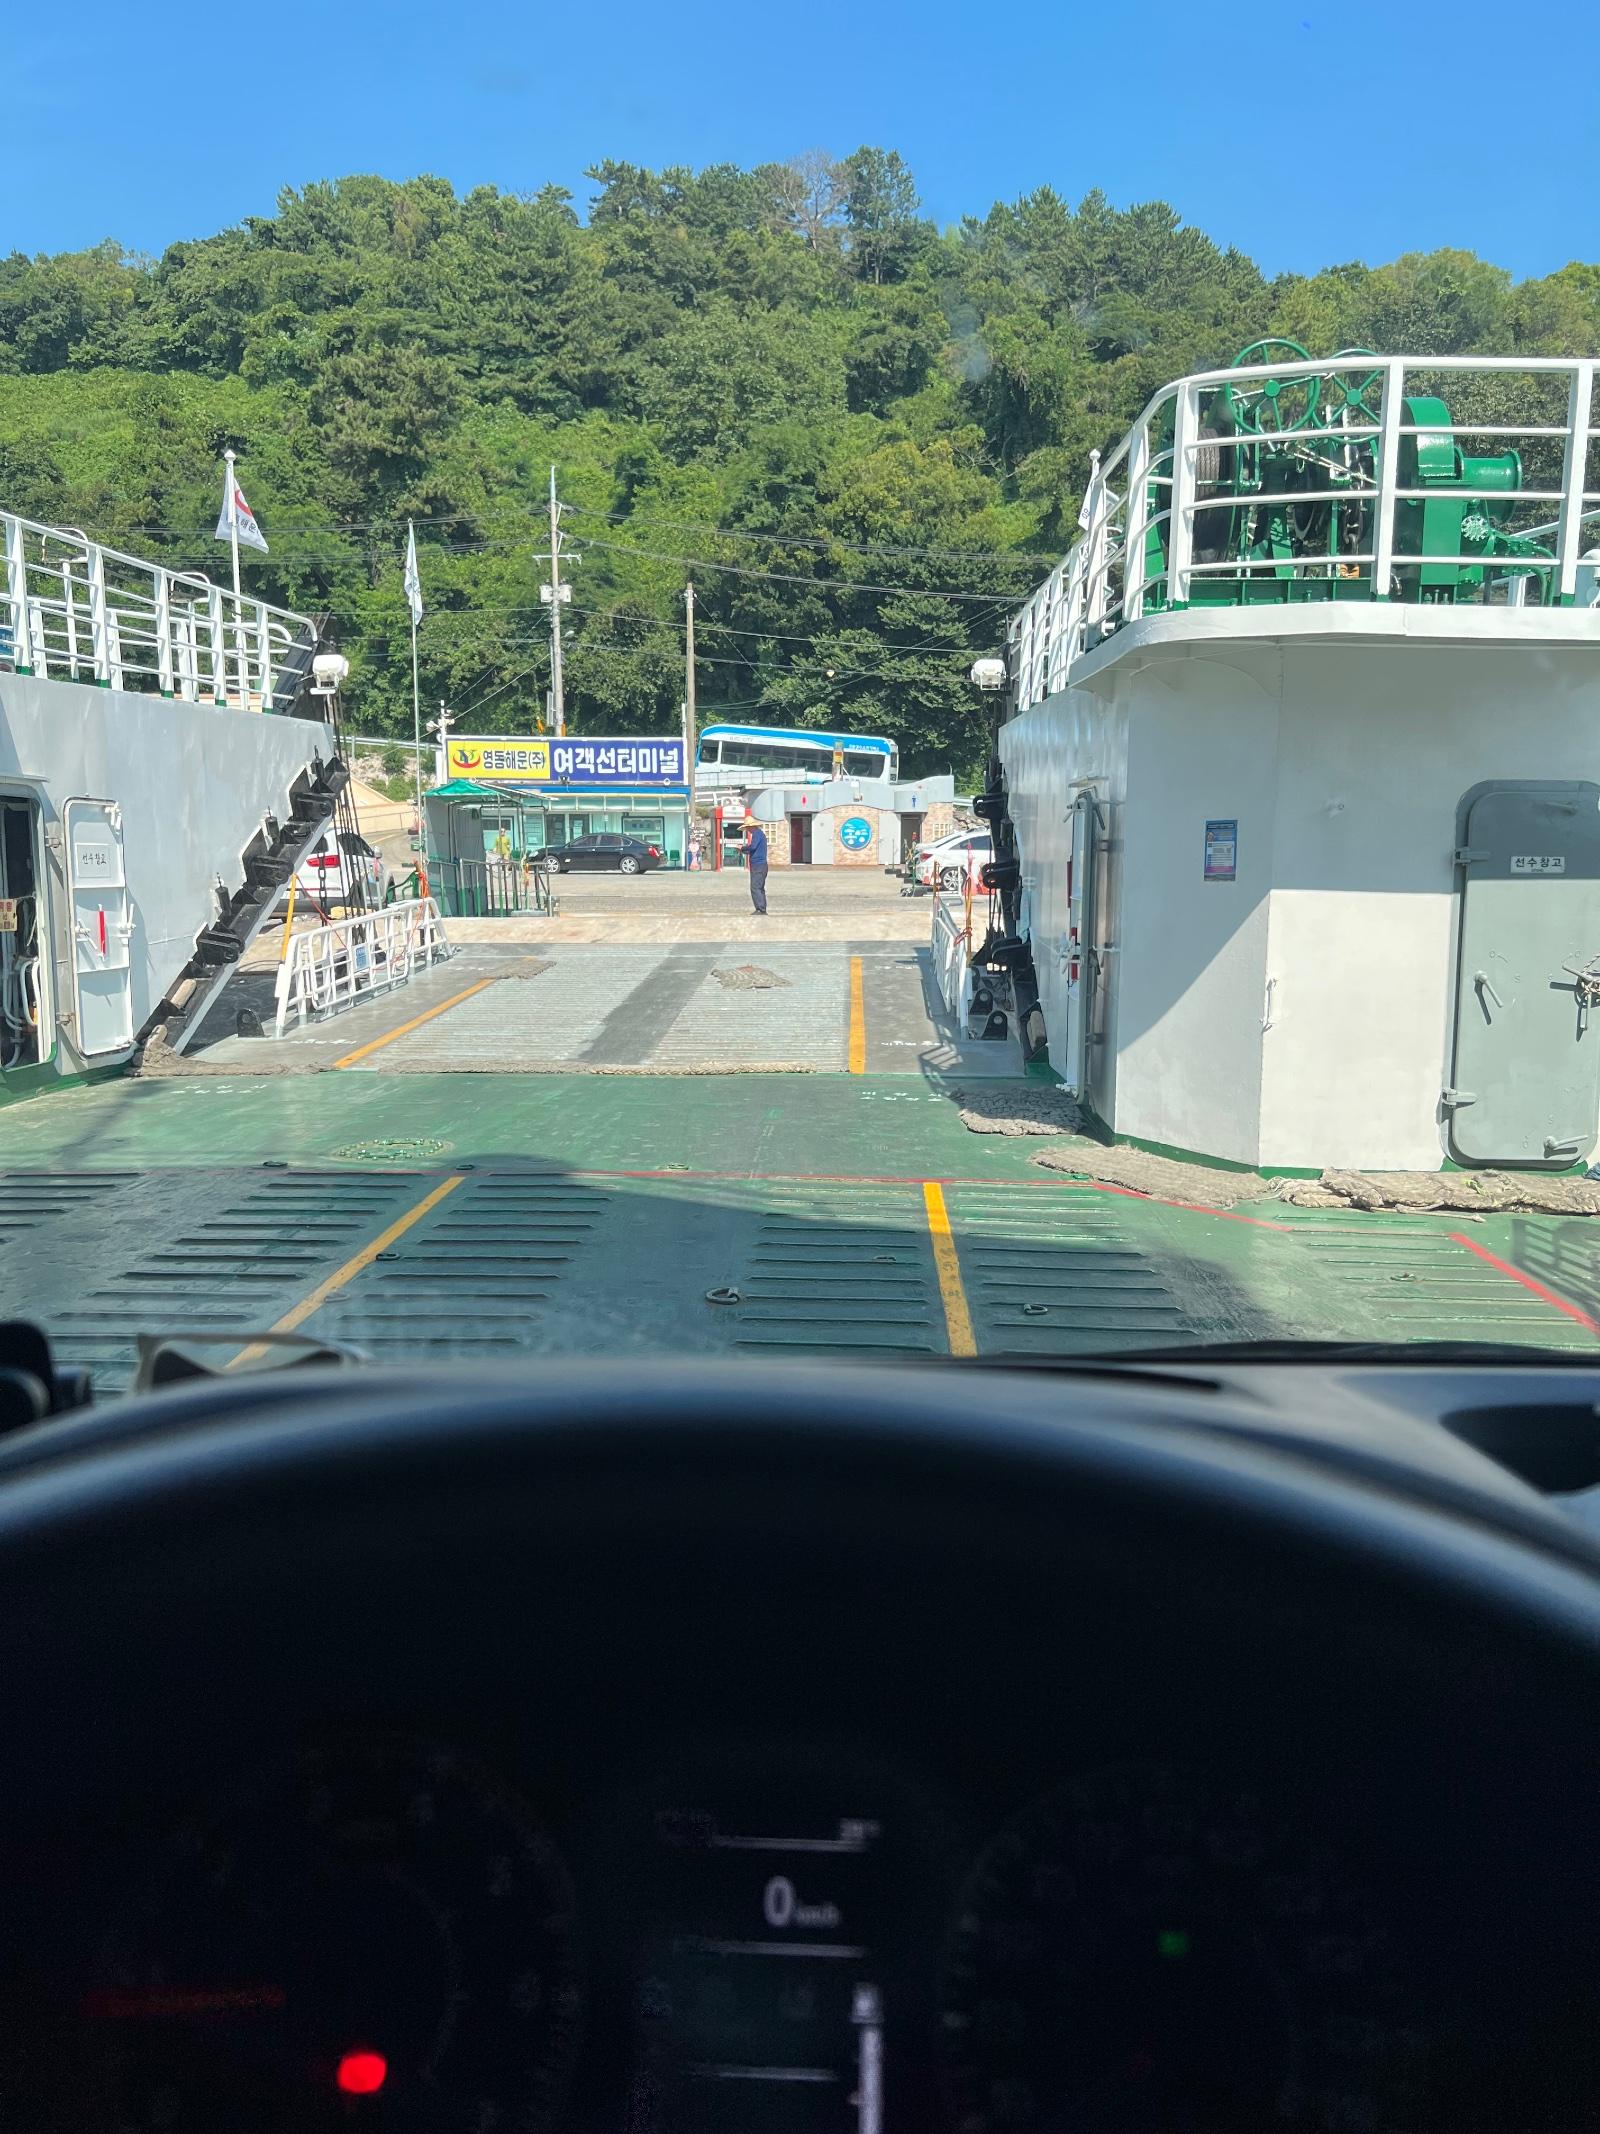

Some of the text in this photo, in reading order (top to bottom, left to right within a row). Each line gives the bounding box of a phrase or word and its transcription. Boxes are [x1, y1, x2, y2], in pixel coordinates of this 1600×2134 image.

[483, 750, 545, 770] 영동해운(주)
[553, 747, 679, 774] 여객선터미널
[1515, 857, 1562, 868] 선수창고
[765, 1876, 793, 1926] 0
